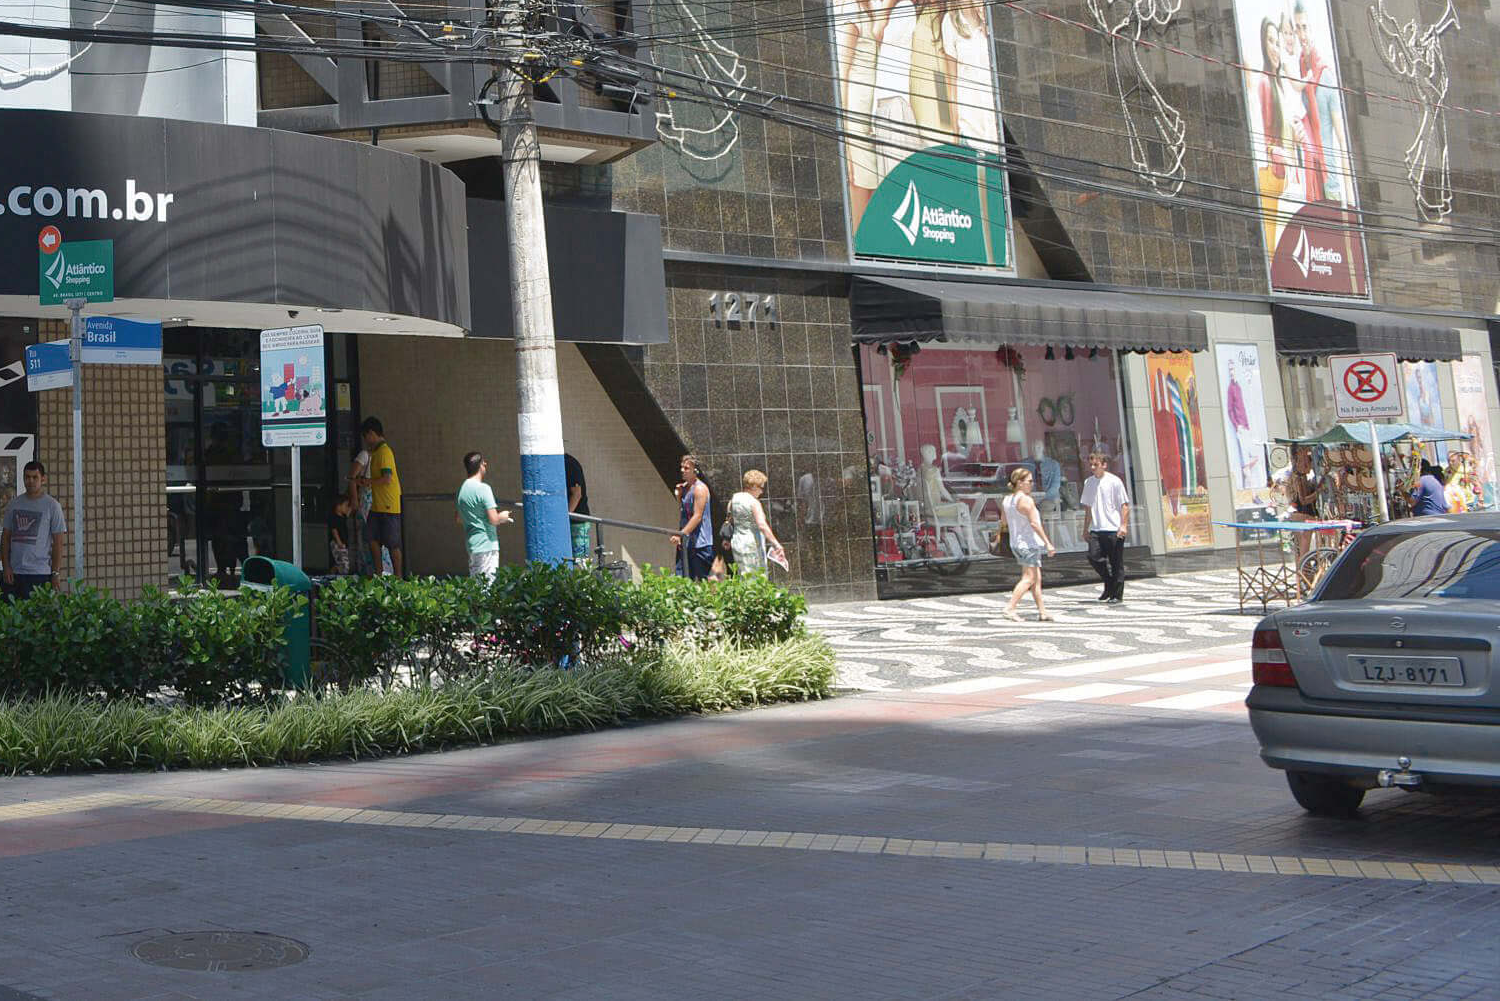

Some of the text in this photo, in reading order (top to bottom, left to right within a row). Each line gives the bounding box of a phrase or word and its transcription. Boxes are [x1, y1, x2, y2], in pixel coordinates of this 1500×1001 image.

[922, 205, 972, 229] Atlântico
[922, 227, 956, 244] Shopping
[65, 263, 106, 275] Atlântico
[65, 276, 91, 284] Shopping
[708, 292, 776, 323] 1271
[87, 320, 113, 330] Avenida
[87, 331, 116, 343] Brasil
[30, 359, 40, 368] 511
[1363, 666, 1448, 683] LZJ-8171
